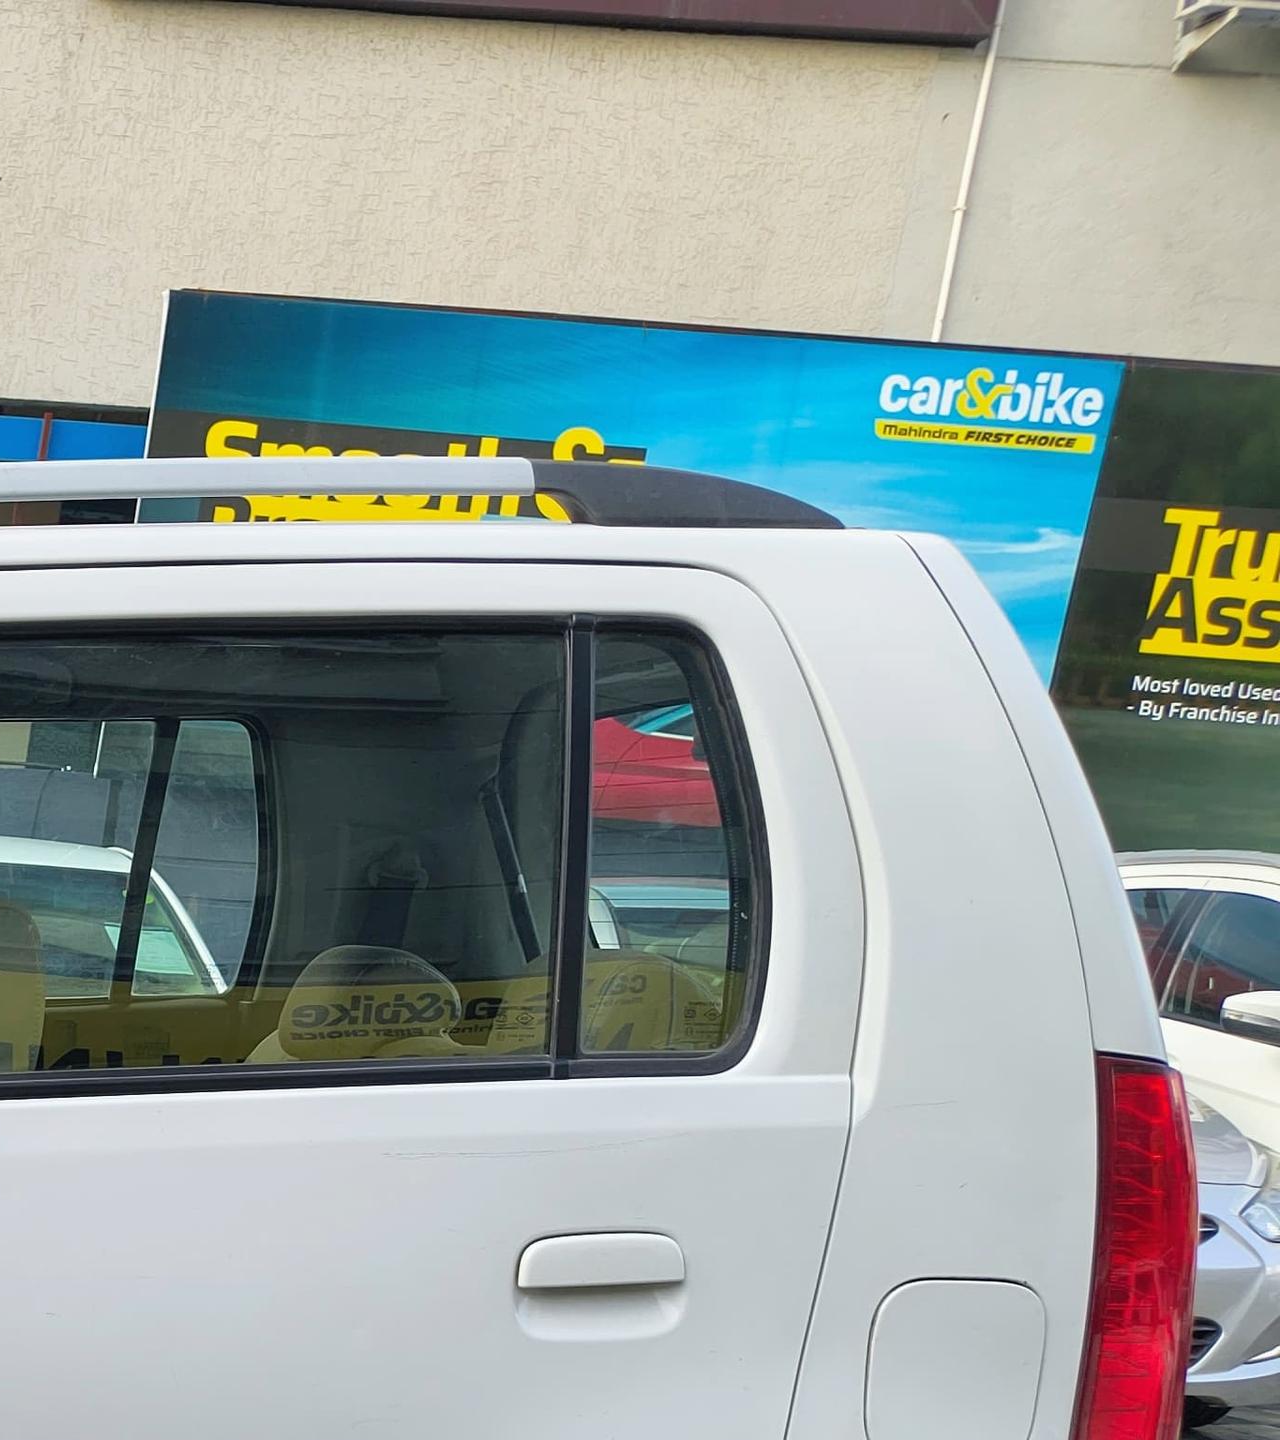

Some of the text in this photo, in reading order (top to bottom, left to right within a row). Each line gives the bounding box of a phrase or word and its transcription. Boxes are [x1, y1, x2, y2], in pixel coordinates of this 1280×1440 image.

[878, 367, 1105, 427] car&bike
[882, 423, 1077, 449] Mahindra FIRST CHOICE
[1132, 675, 1179, 693] Most
[1183, 678, 1234, 699] loved
[1139, 700, 1164, 721] By
[1168, 703, 1258, 724] Franchise
